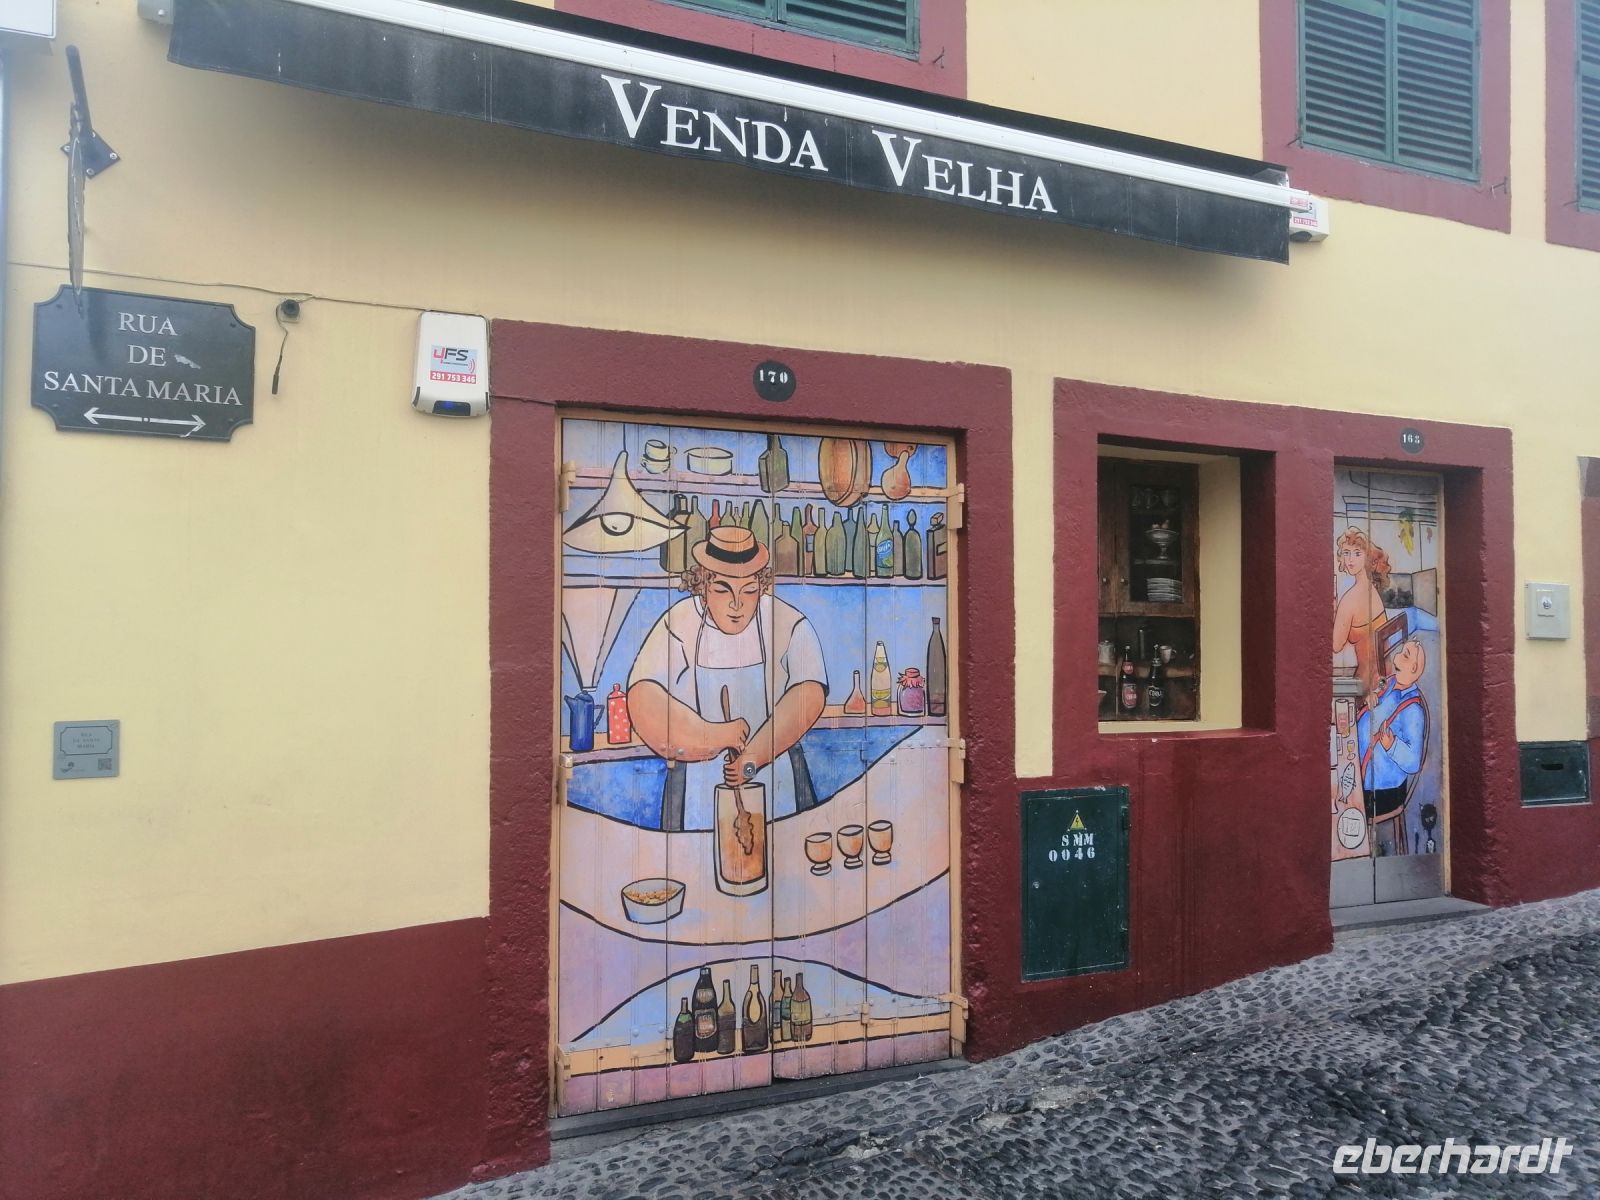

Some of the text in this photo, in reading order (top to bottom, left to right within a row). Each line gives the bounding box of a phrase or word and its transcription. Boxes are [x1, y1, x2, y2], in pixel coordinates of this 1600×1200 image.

[601, 74, 1058, 214] VENDA VELHA
[117, 311, 178, 336] RUA
[127, 344, 167, 367] DE
[432, 372, 444, 381] 291
[447, 373, 460, 381] 753
[760, 369, 788, 384] 170
[44, 371, 243, 406] SANTA MARIA
[1048, 846, 1096, 862] 0046
